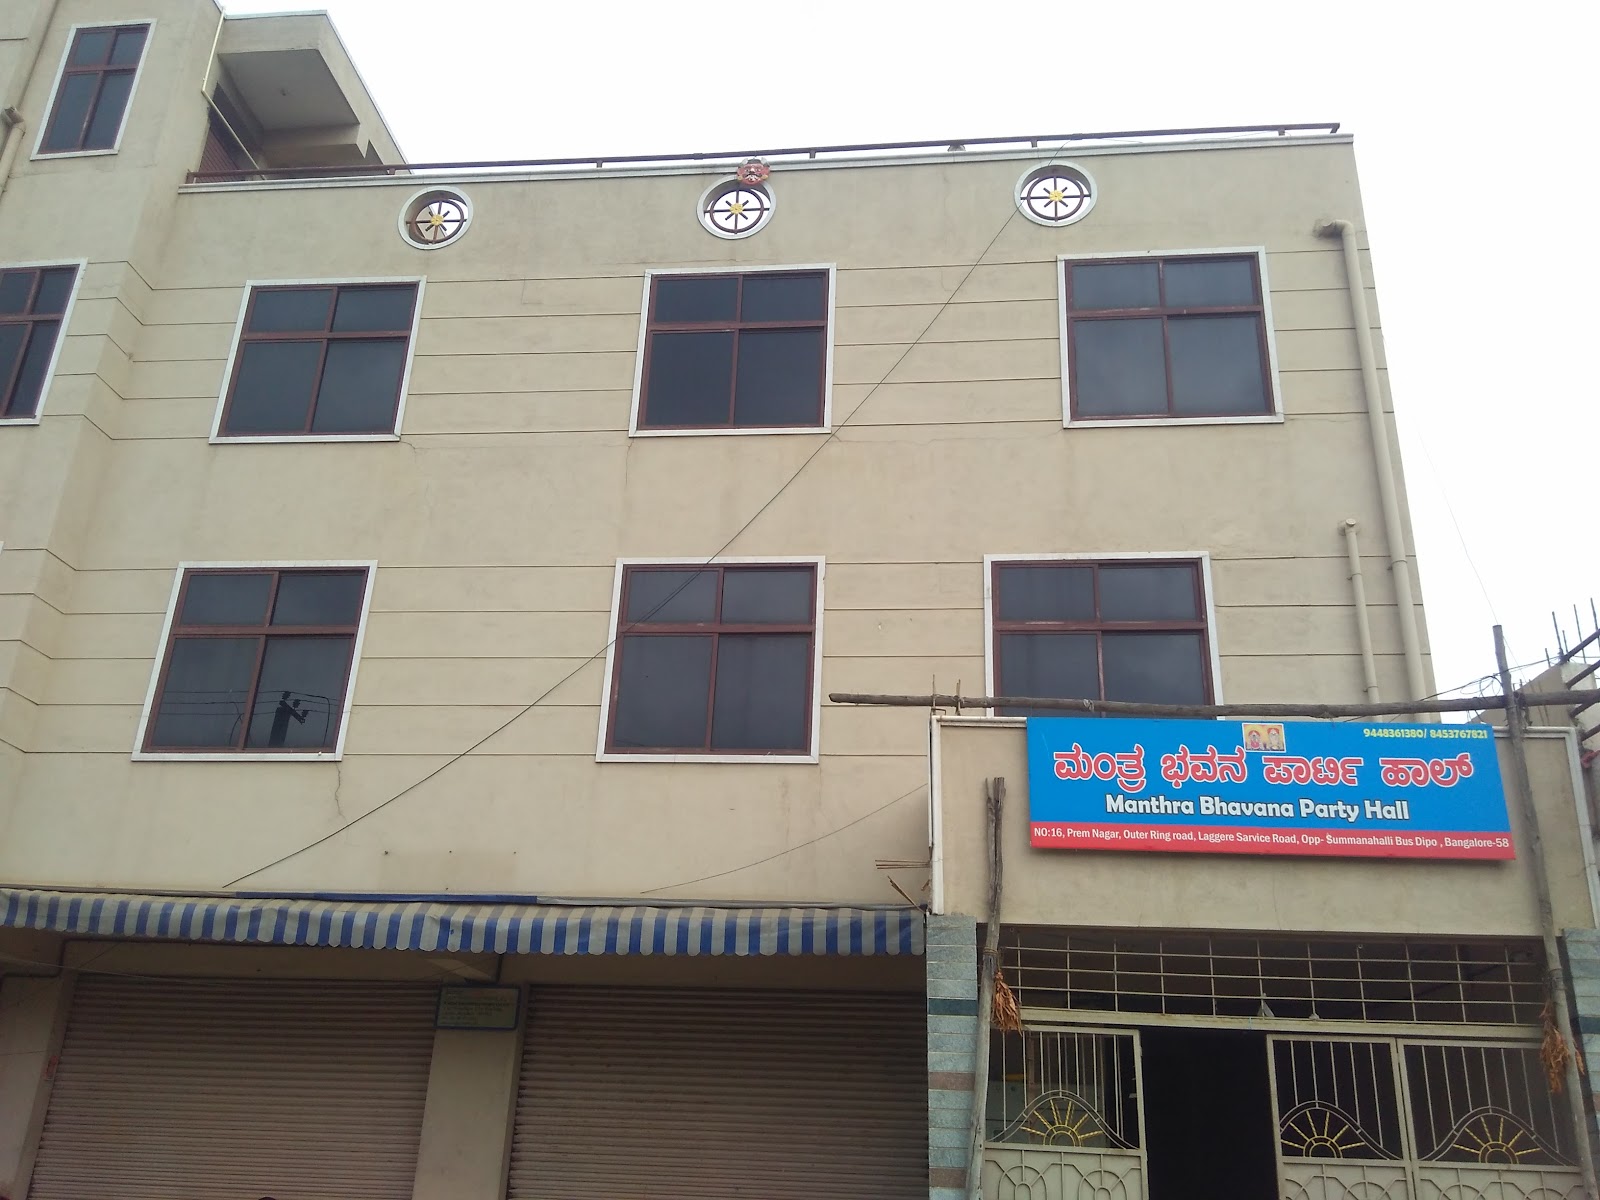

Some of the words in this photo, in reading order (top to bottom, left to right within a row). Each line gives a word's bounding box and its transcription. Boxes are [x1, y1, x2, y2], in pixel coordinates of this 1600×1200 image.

[1054, 743, 1147, 793] ಮಂತ್ರ
[1160, 744, 1247, 789] ಭವನ
[1379, 752, 1474, 788] ಹಾಲ್
[1105, 794, 1195, 815] Manthra
[1199, 796, 1295, 817] Bhavana
[1299, 798, 1360, 822] Party
[1363, 799, 1410, 820] Hall
[1034, 827, 1065, 839] NO:16,
[1067, 828, 1091, 838] Prem
[1092, 829, 1121, 841] Nagar,
[1123, 829, 1149, 840] Outer
[1150, 830, 1171, 842] Ring
[1172, 831, 1196, 842] road,
[1198, 831, 1234, 844] Laggere
[1272, 833, 1299, 845] Road,
[1301, 834, 1324, 847] Opp-
[1326, 834, 1393, 846] Summanahalli
[1395, 836, 1414, 846] Bus
[1415, 836, 1437, 848] Dipo
[1444, 837, 1509, 850] Bangalore-58
